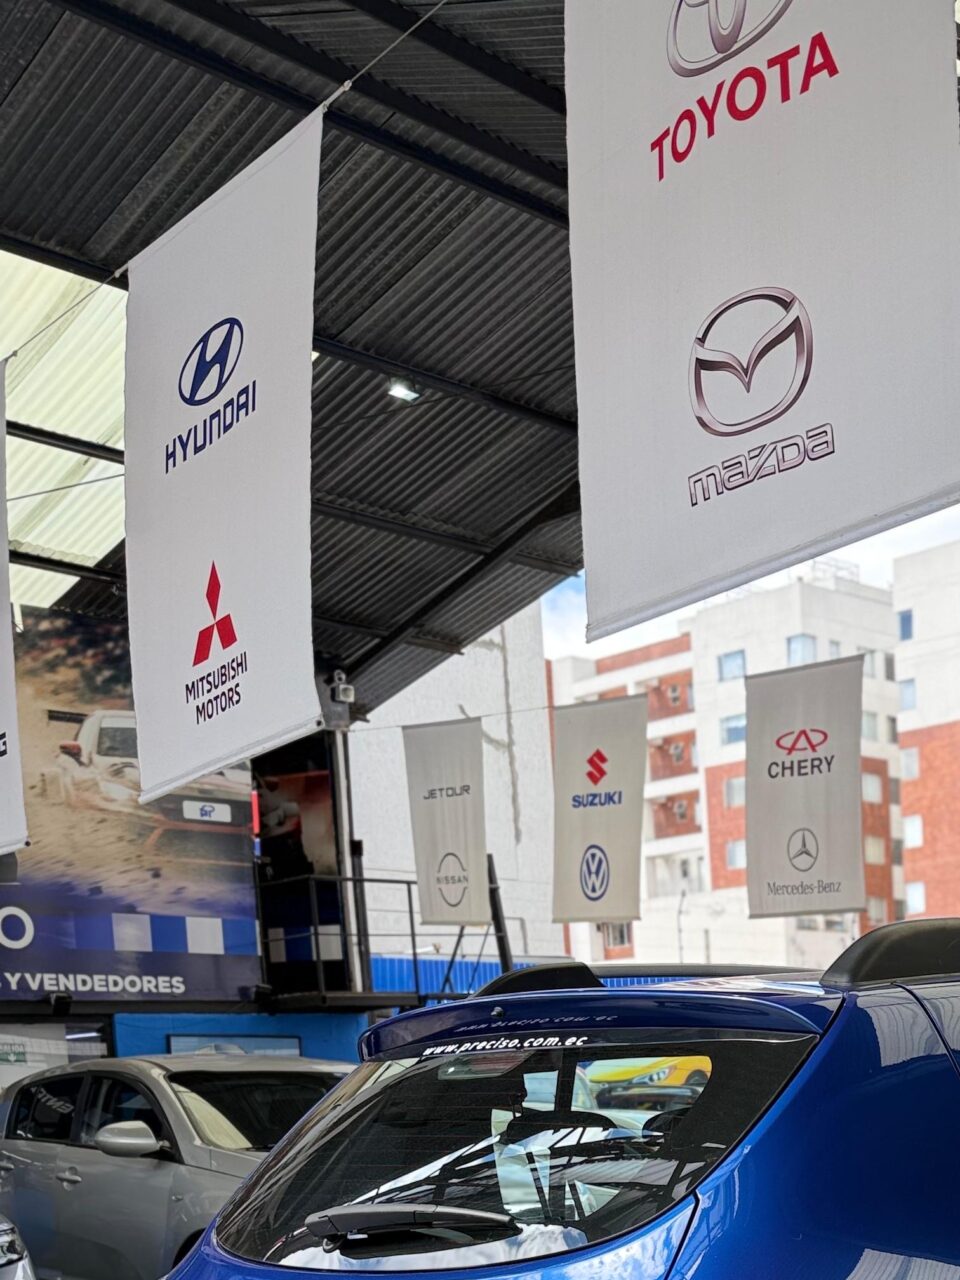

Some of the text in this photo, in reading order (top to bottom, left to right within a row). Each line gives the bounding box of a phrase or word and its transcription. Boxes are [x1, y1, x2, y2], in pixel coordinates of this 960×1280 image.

[650, 32, 839, 182] TOYOTA
[165, 380, 257, 475] HYUNDAI
[185, 651, 248, 704] MITSUBISHI
[195, 682, 242, 725] MOTORS
[767, 754, 836, 779] CHERY
[423, 784, 471, 800] JETOUR
[571, 790, 623, 809] SUZUKI
[436, 874, 469, 885] NISSAN
[767, 879, 842, 896] Mercedes-Benz
[4, 972, 186, 994] Y VENDEDORES
